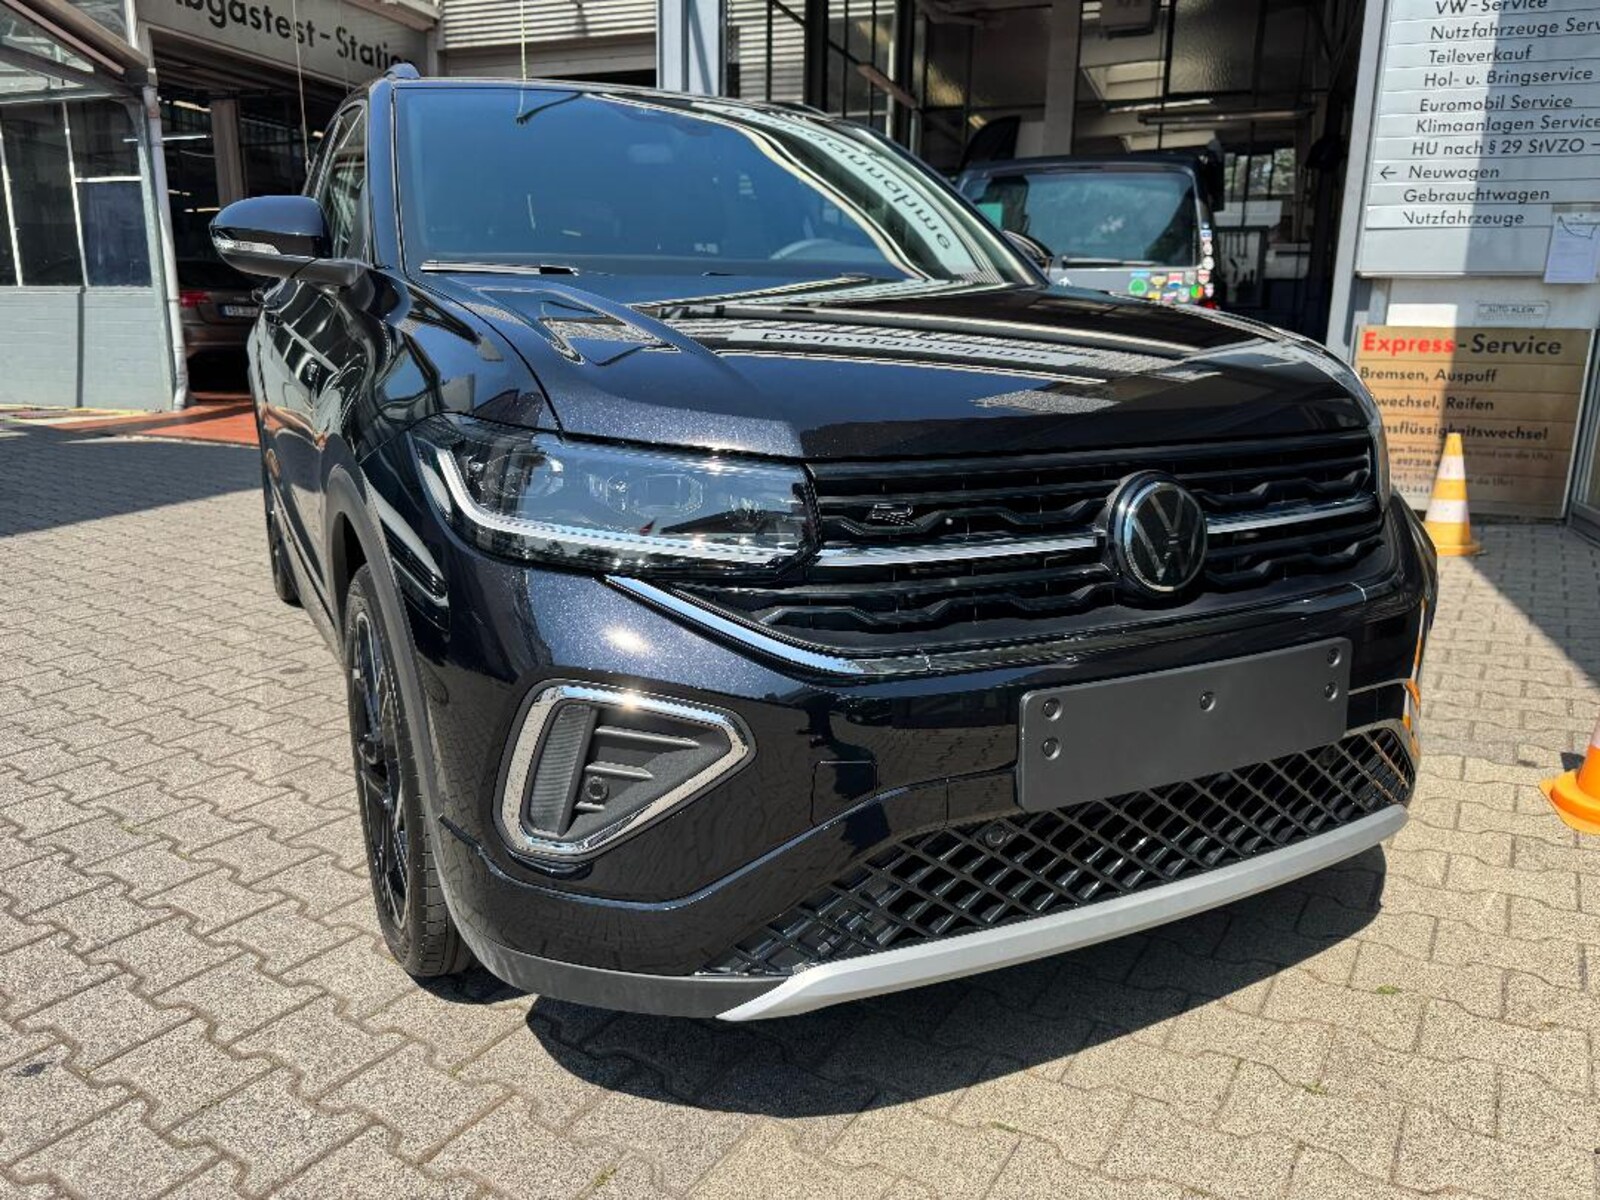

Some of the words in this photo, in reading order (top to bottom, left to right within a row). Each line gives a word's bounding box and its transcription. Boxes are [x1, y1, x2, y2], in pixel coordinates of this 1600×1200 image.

[1435, 0, 1548, 15] VW-Service
[1430, 21, 1560, 40] Nutzfahrzeuge
[1429, 45, 1533, 64] Teileverkauf
[1424, 71, 1460, 87] Hol-
[1466, 75, 1480, 86] u.
[1487, 66, 1593, 86] Bringservice
[1420, 95, 1505, 112] Euromobil
[1510, 94, 1573, 109] Service
[1416, 116, 1534, 135] Klimaanlagen
[1540, 114, 1600, 130] Service
[1412, 141, 1439, 156] HU
[1443, 139, 1483, 155] nach
[1501, 140, 1522, 154] 29
[1528, 138, 1585, 154] StVZO
[1408, 165, 1500, 182] Neuwagen
[1403, 187, 1550, 204] Gebrauchtwagen
[1403, 210, 1525, 228] Nutzfahrzeuge
[1362, 332, 1562, 356] Express-Service
[1360, 366, 1430, 383] Bremsen,
[1434, 368, 1498, 384] Auspuff
[1446, 396, 1494, 411] Reifen
